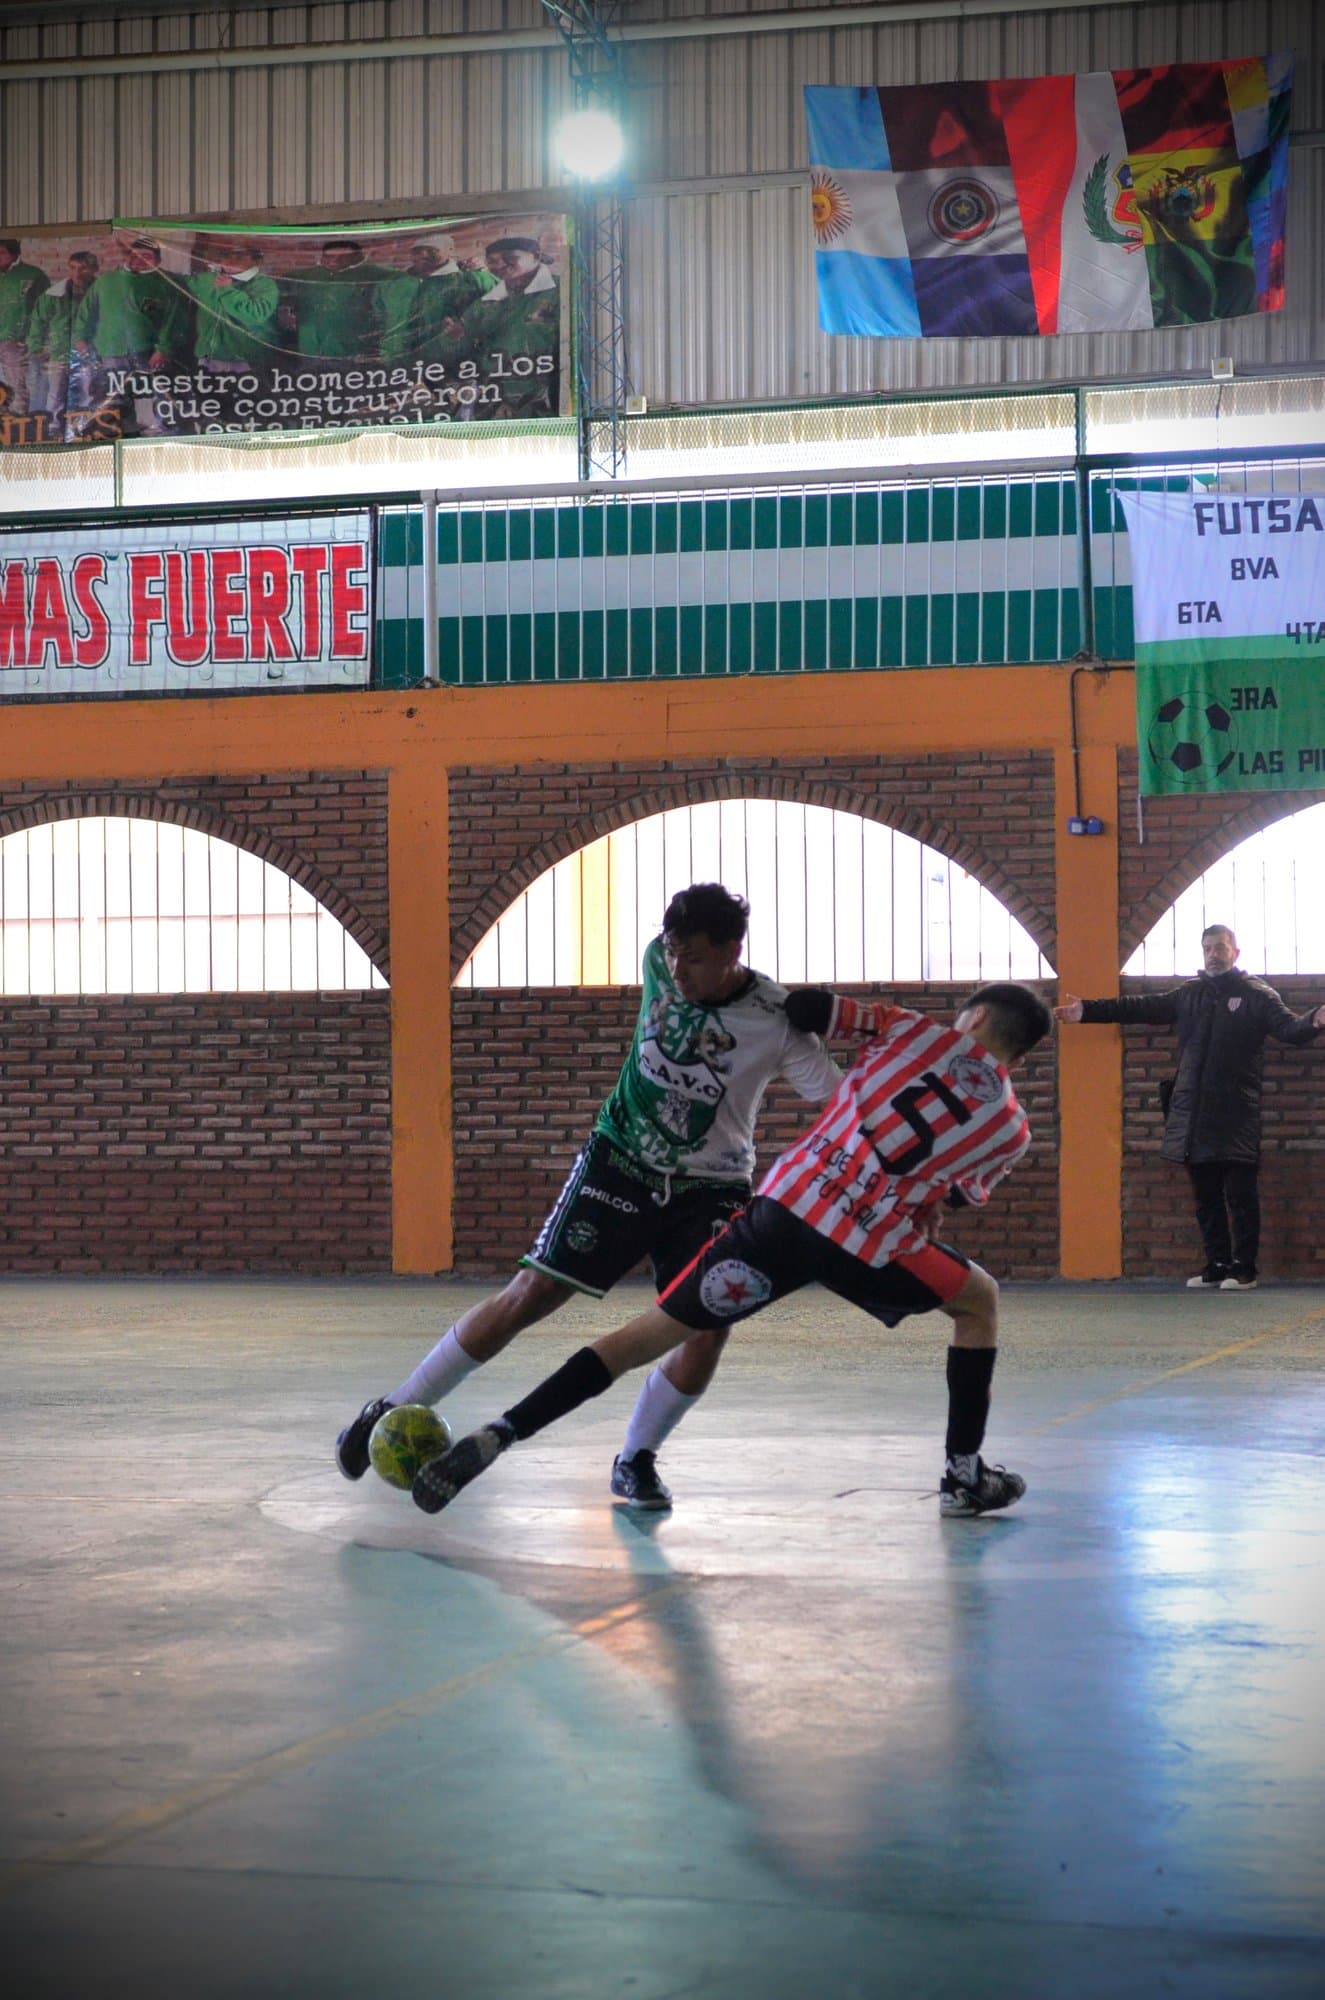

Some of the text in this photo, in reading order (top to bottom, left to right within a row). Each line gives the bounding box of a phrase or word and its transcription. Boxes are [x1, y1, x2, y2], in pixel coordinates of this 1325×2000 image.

[106, 353, 555, 396] Nuestro homenaje a los
[156, 383, 502, 425] que construyeron
[1230, 557, 1280, 581] 8VA
[125, 541, 367, 667] FUERTE
[1177, 601, 1222, 625] 6TA
[1230, 687, 1278, 711] 3RA
[1239, 748, 1325, 776] LAS PI
[857, 1071, 974, 1176] 5
[580, 1185, 633, 1213] PHILCO
